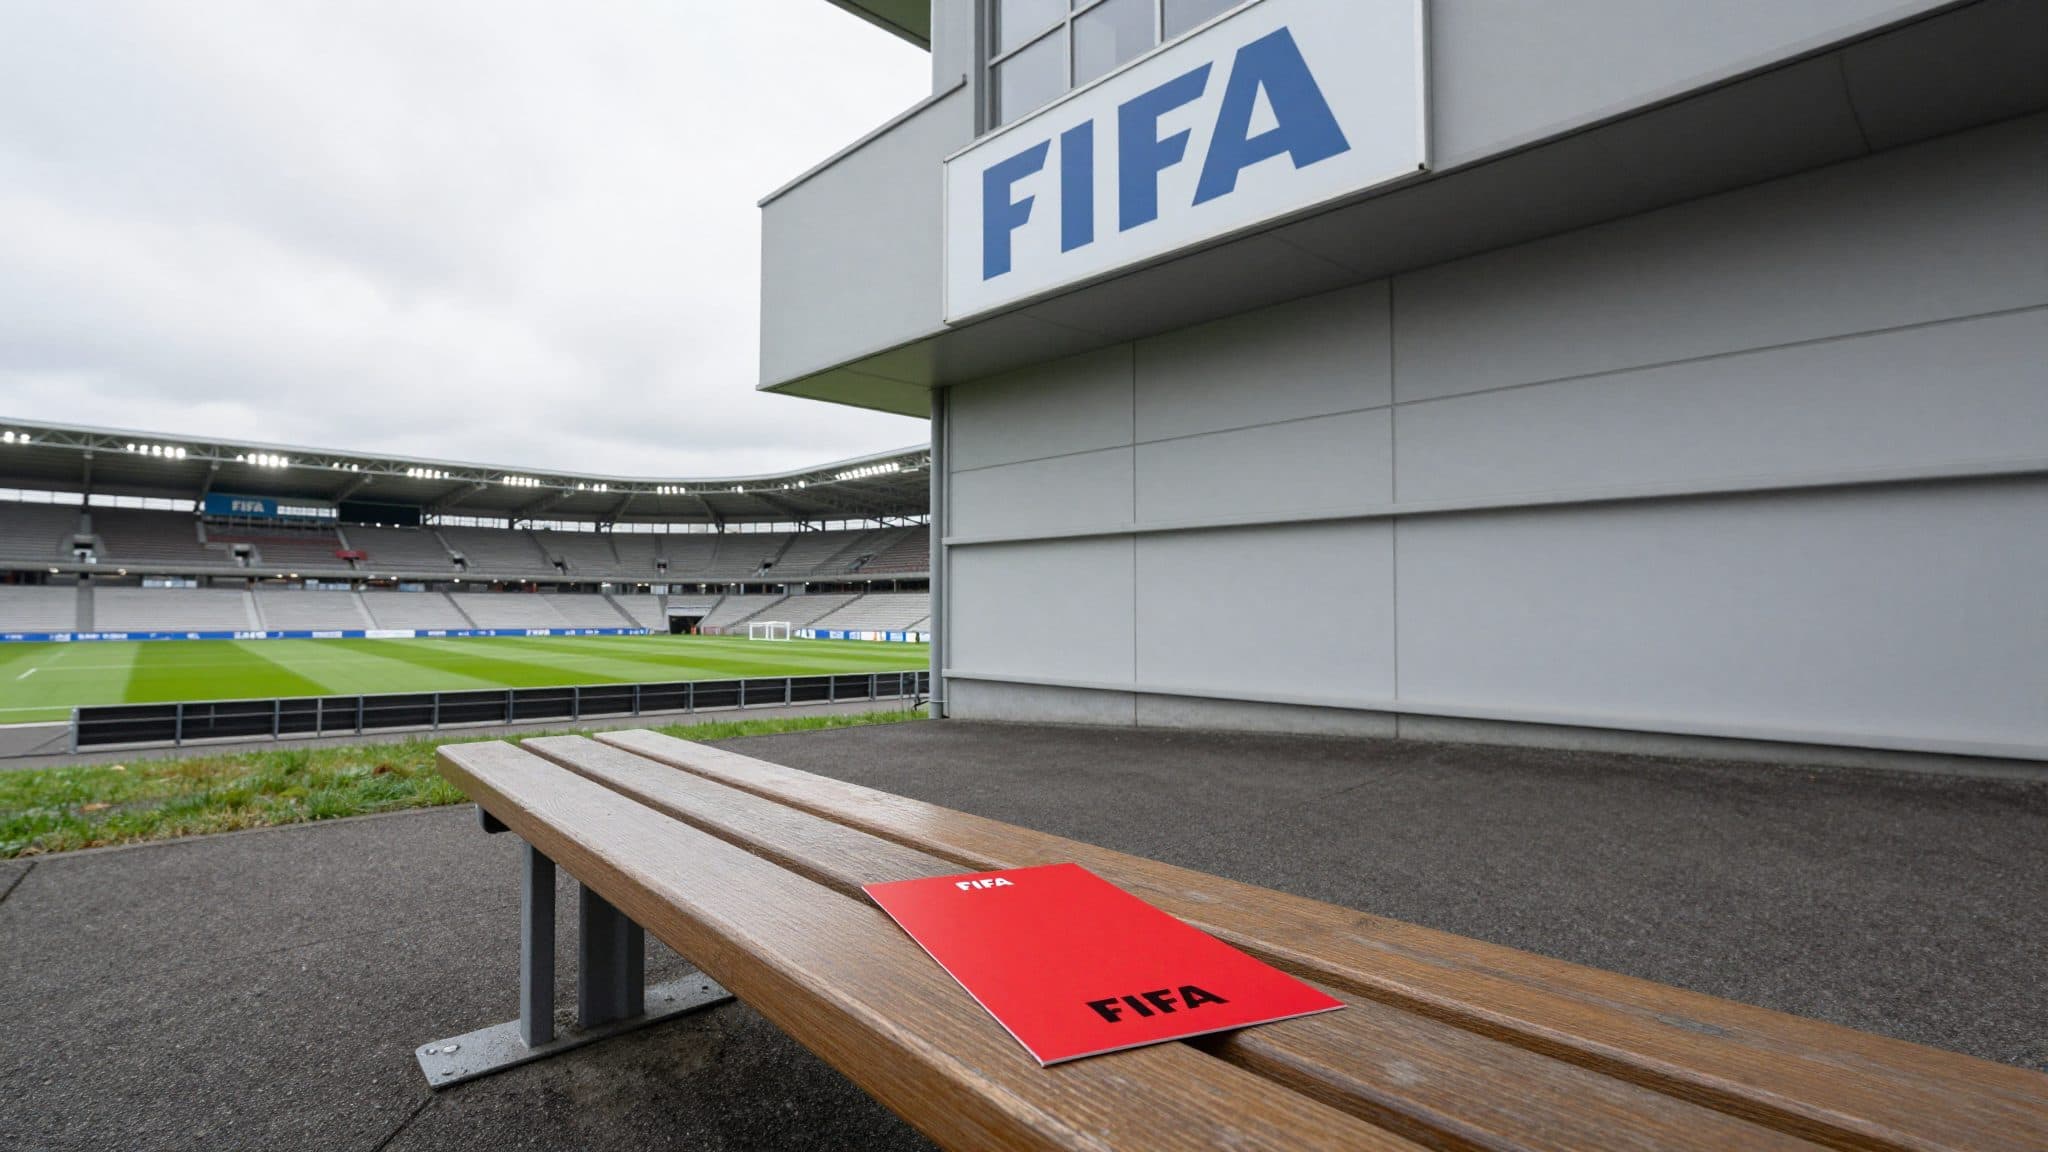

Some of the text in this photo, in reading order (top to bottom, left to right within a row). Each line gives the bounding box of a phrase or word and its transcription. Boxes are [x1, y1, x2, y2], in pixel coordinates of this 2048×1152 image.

[982, 26, 1351, 281] FIFA
[231, 500, 264, 512] FIFA
[955, 877, 1015, 891] FIFA
[1086, 985, 1230, 1024] FIFA
